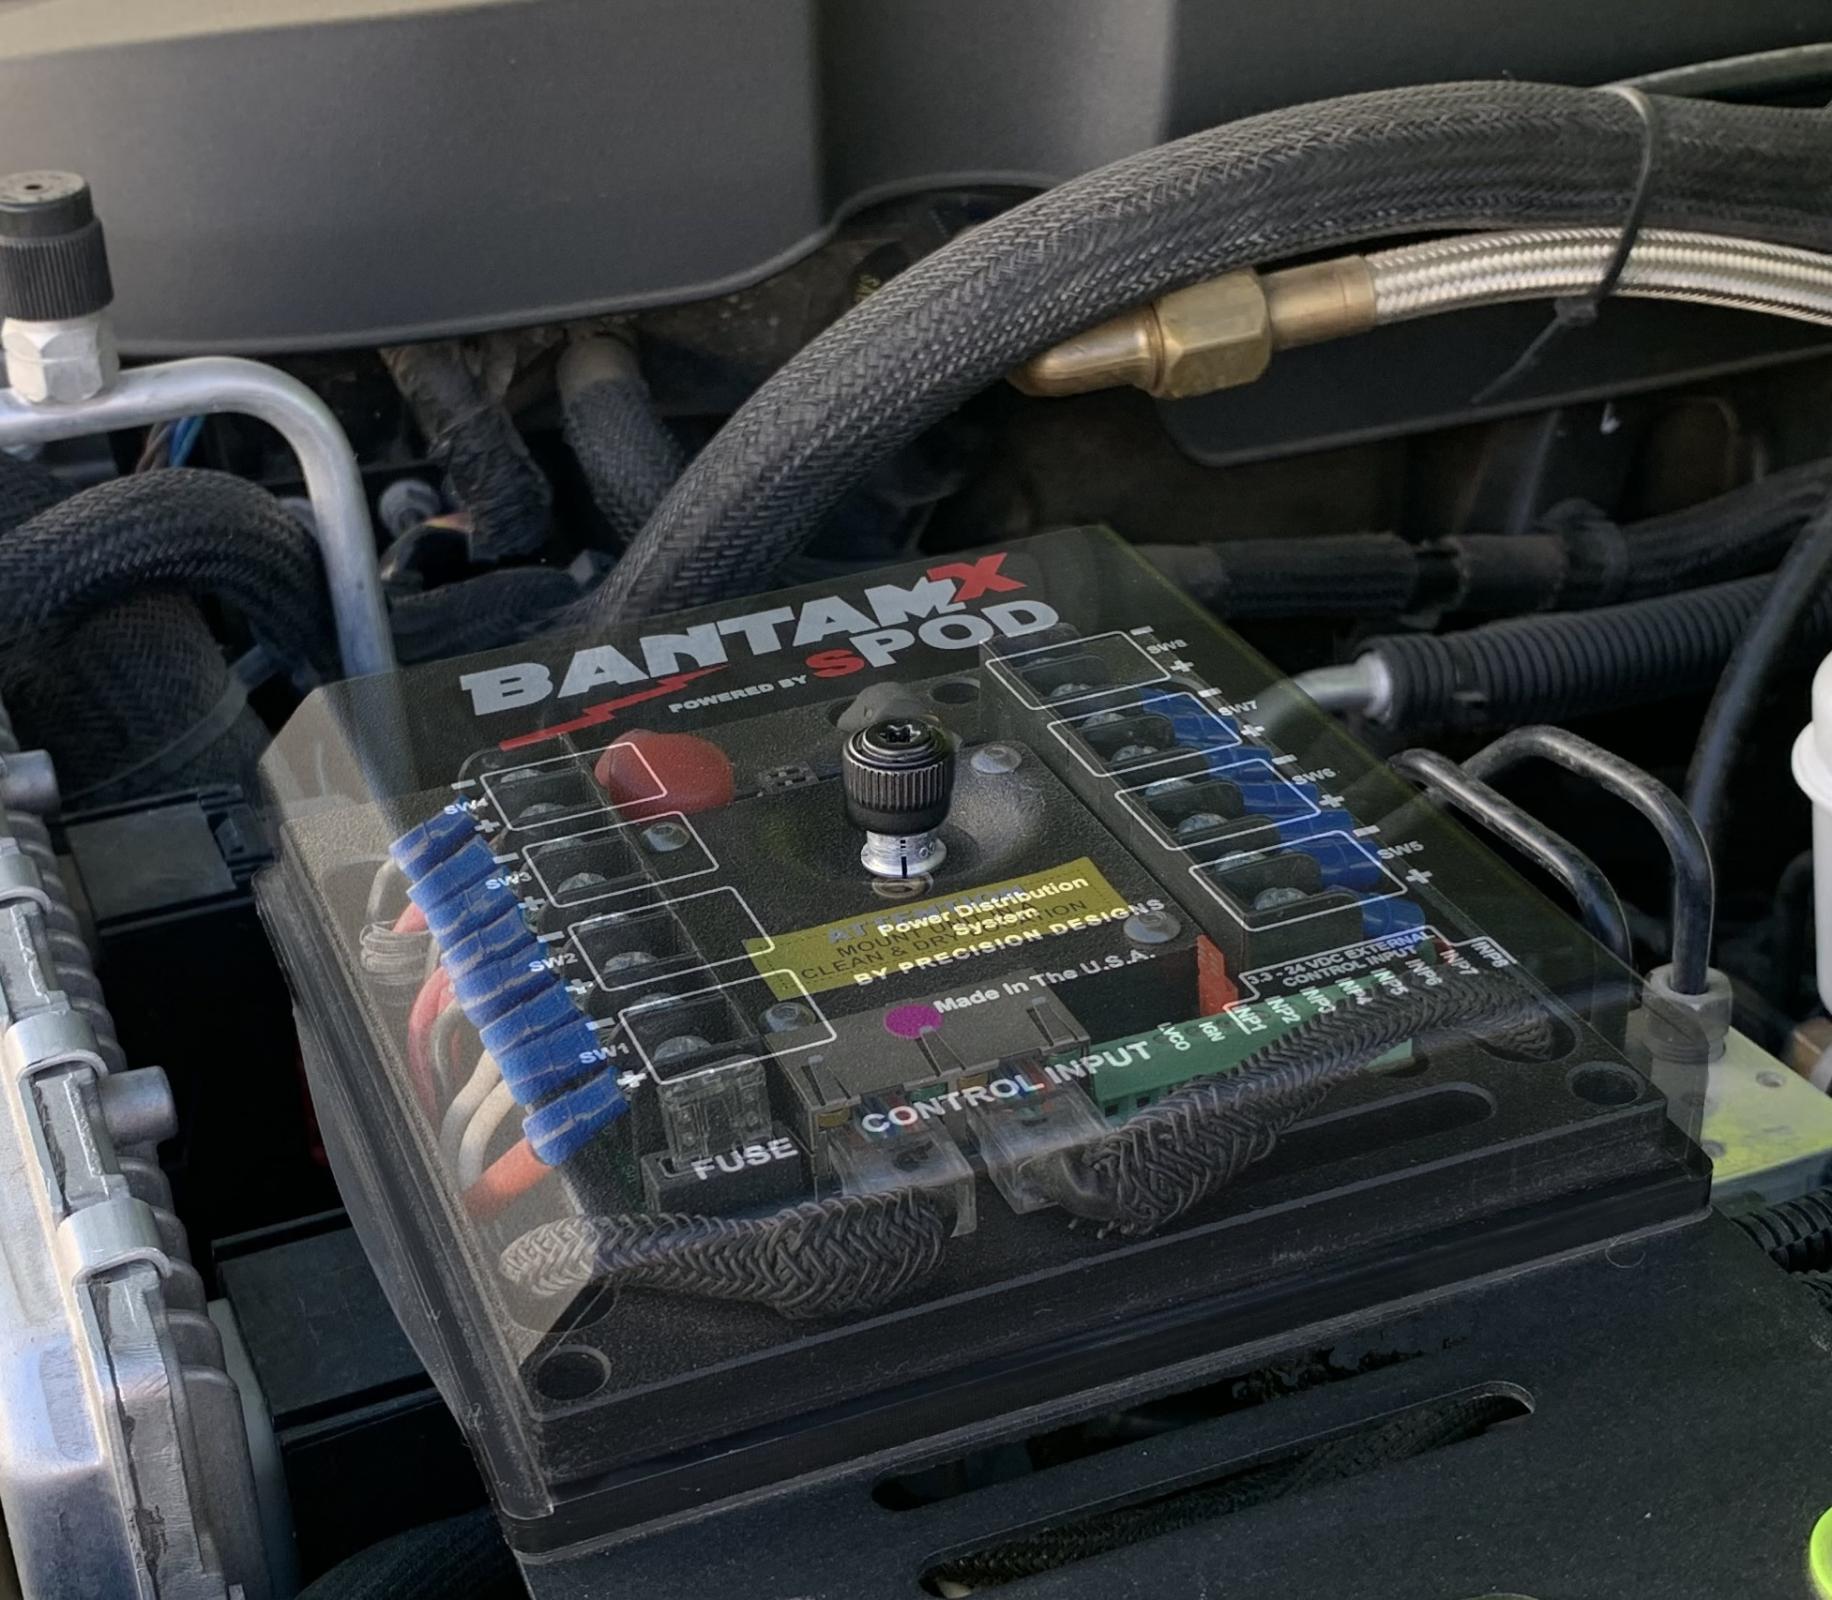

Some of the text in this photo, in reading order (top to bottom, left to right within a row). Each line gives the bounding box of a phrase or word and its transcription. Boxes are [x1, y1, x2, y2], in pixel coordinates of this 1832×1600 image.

[668, 600, 1060, 713] POWERED BY SPOD
[1217, 700, 1258, 718] SW7
[1291, 767, 1337, 788] SW6
[444, 797, 489, 817] SW4
[1376, 840, 1425, 861] SW5
[485, 870, 533, 891] SW3
[877, 877, 1090, 938] Power Distribution
[952, 907, 1041, 937] System
[801, 952, 885, 979] CLEAN
[913, 930, 960, 952] DRY
[836, 925, 924, 958] MOUNT
[854, 899, 1166, 987] BY PRECISION DESIGNS
[1471, 940, 1510, 969] INP8
[528, 952, 578, 973] SW2
[1248, 971, 1274, 985] 3.3
[1284, 963, 1306, 976] 24
[1305, 953, 1344, 971] VDC
[1343, 931, 1436, 960] EXTERNAL
[1283, 945, 1418, 987] CONTROL INPUT
[1405, 958, 1443, 987] INP6
[1439, 949, 1479, 976] INP7
[934, 949, 1156, 1013] Made In The U.S.A.
[1335, 976, 1373, 1005] INP4
[1370, 967, 1409, 996] INP5
[1265, 995, 1300, 1024] INP2
[1300, 986, 1336, 1014] INP3
[1198, 1021, 1226, 1042] IGN
[1232, 1004, 1267, 1032] INP1
[1156, 1022, 1191, 1051] LVCO
[579, 1043, 630, 1064] SW1
[862, 1040, 1152, 1133] CONTROL INPUT
[690, 1137, 799, 1181] FUSE
